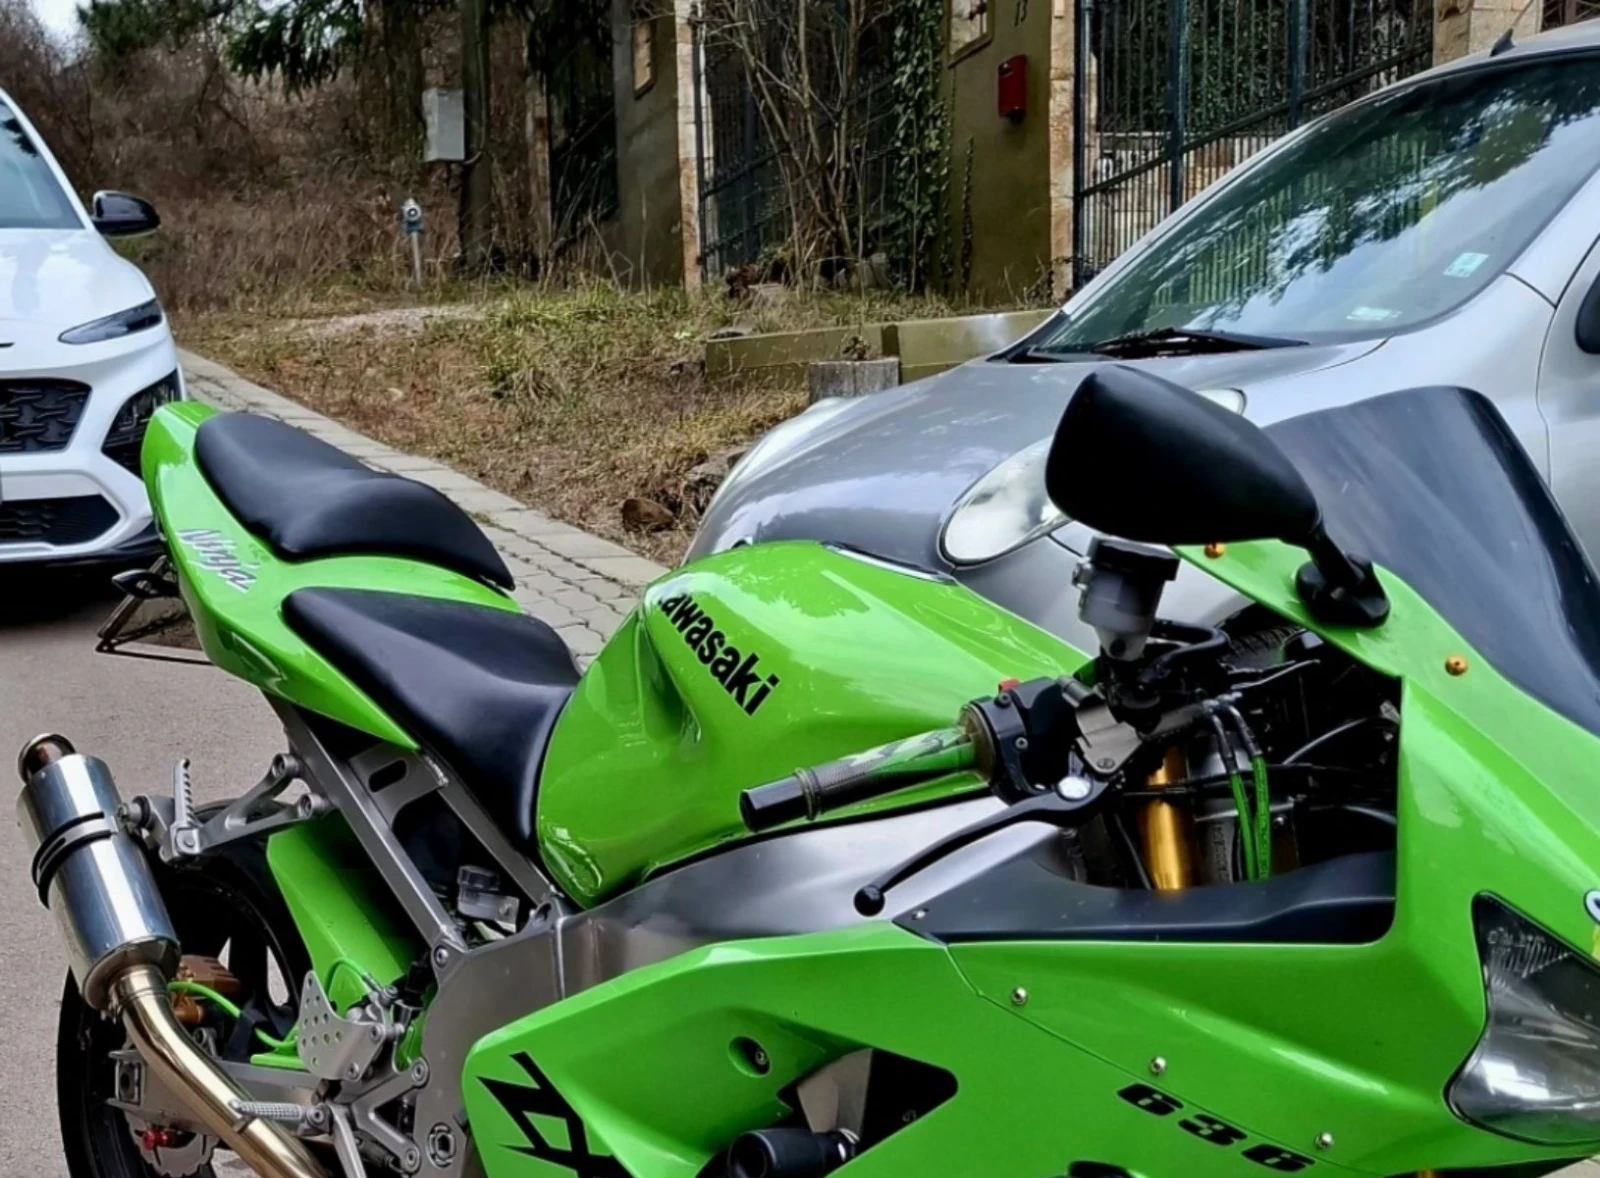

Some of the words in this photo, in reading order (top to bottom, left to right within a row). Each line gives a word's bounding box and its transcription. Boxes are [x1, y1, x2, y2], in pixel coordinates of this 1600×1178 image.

[177, 529, 260, 594] Ninja
[657, 592, 781, 716] awasaki
[1117, 1083, 1316, 1172] 636
